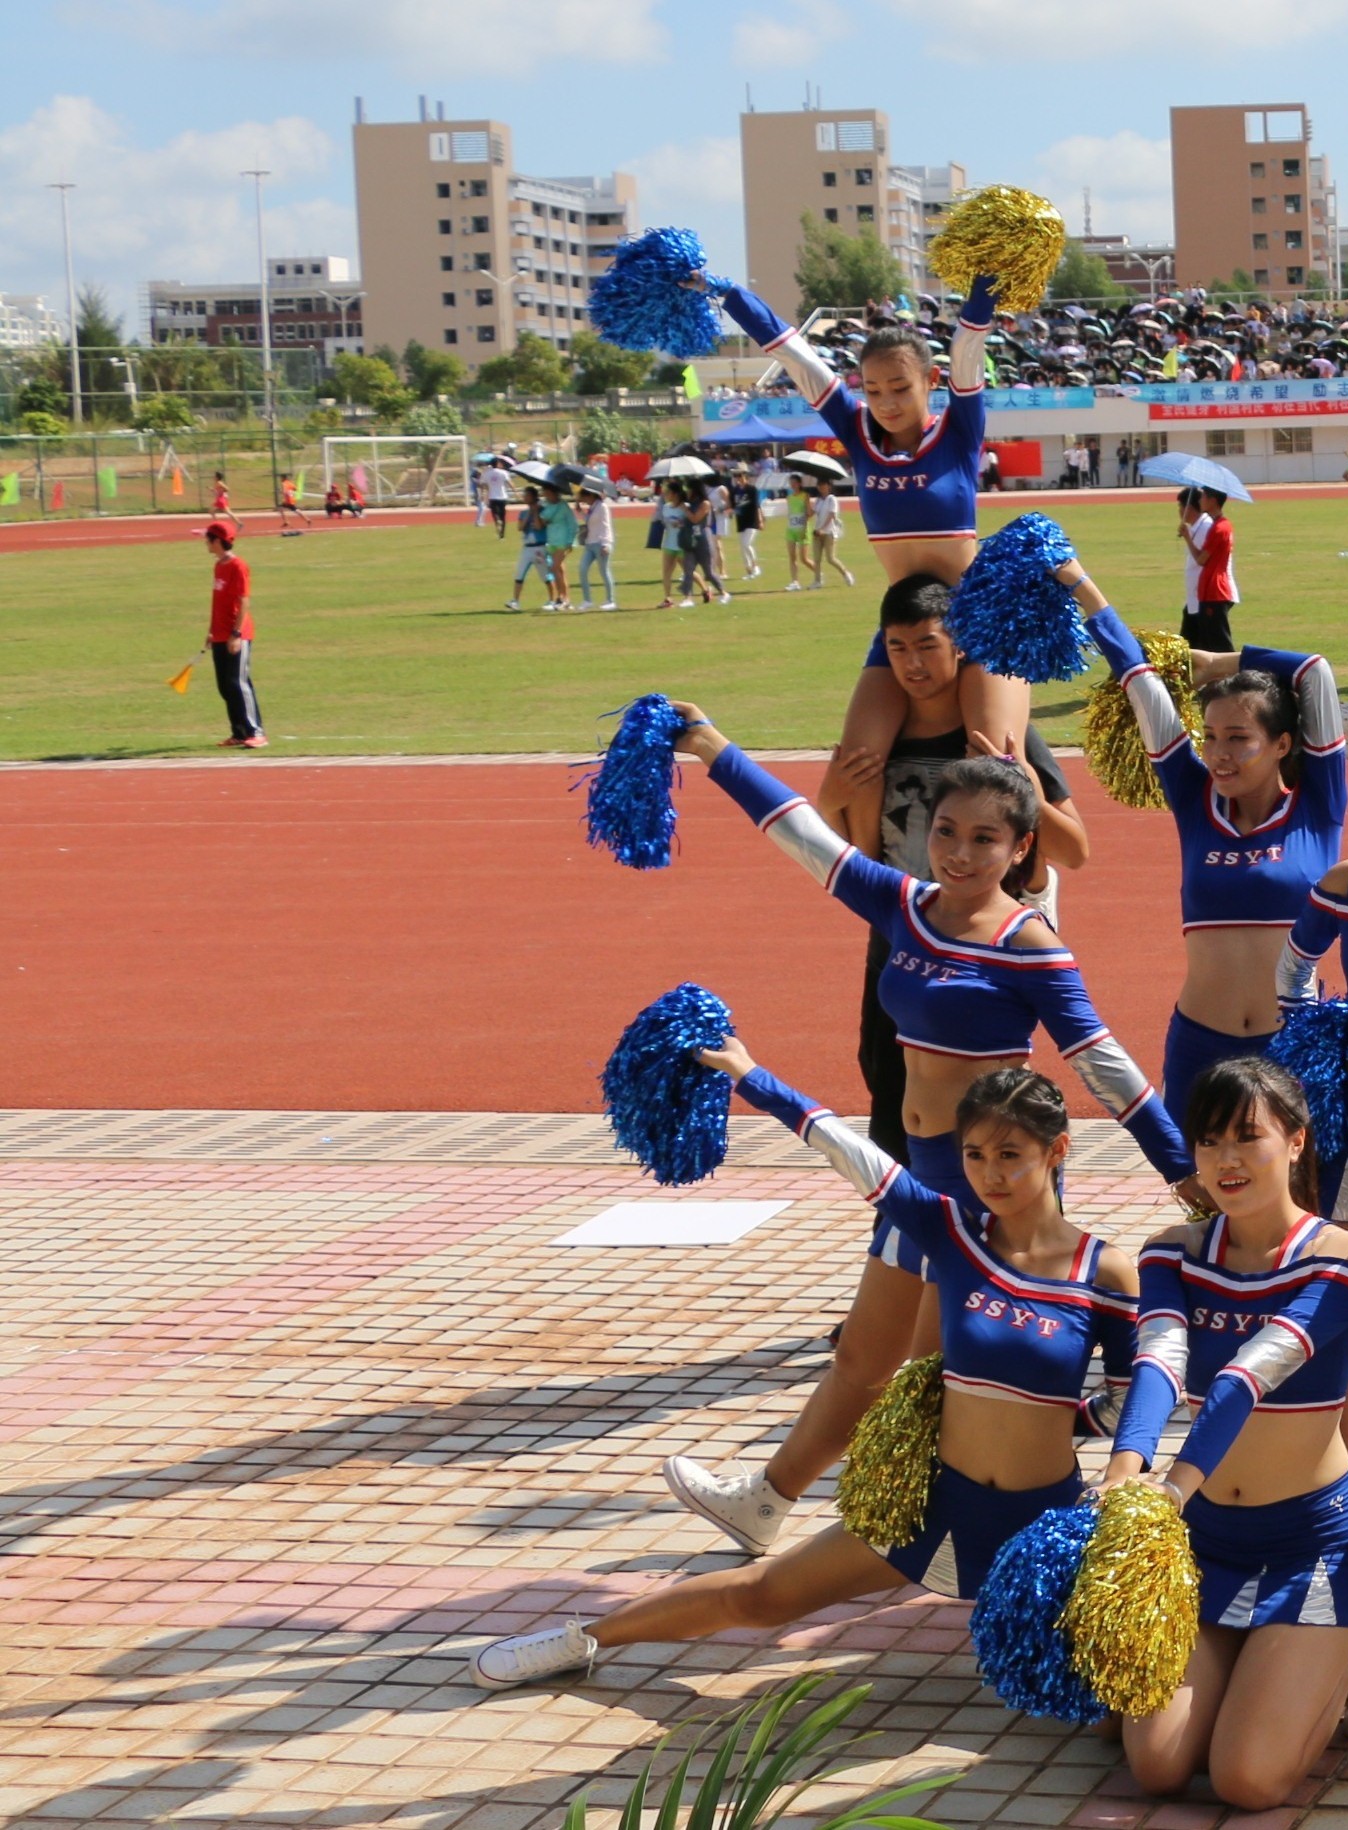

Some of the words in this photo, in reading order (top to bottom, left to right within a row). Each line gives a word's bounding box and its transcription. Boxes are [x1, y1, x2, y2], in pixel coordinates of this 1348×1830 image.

[865, 474, 928, 490] SSYT
[1204, 844, 1283, 865] SSYT
[890, 950, 958, 982] SSYT
[965, 1291, 1060, 1338] SSYT
